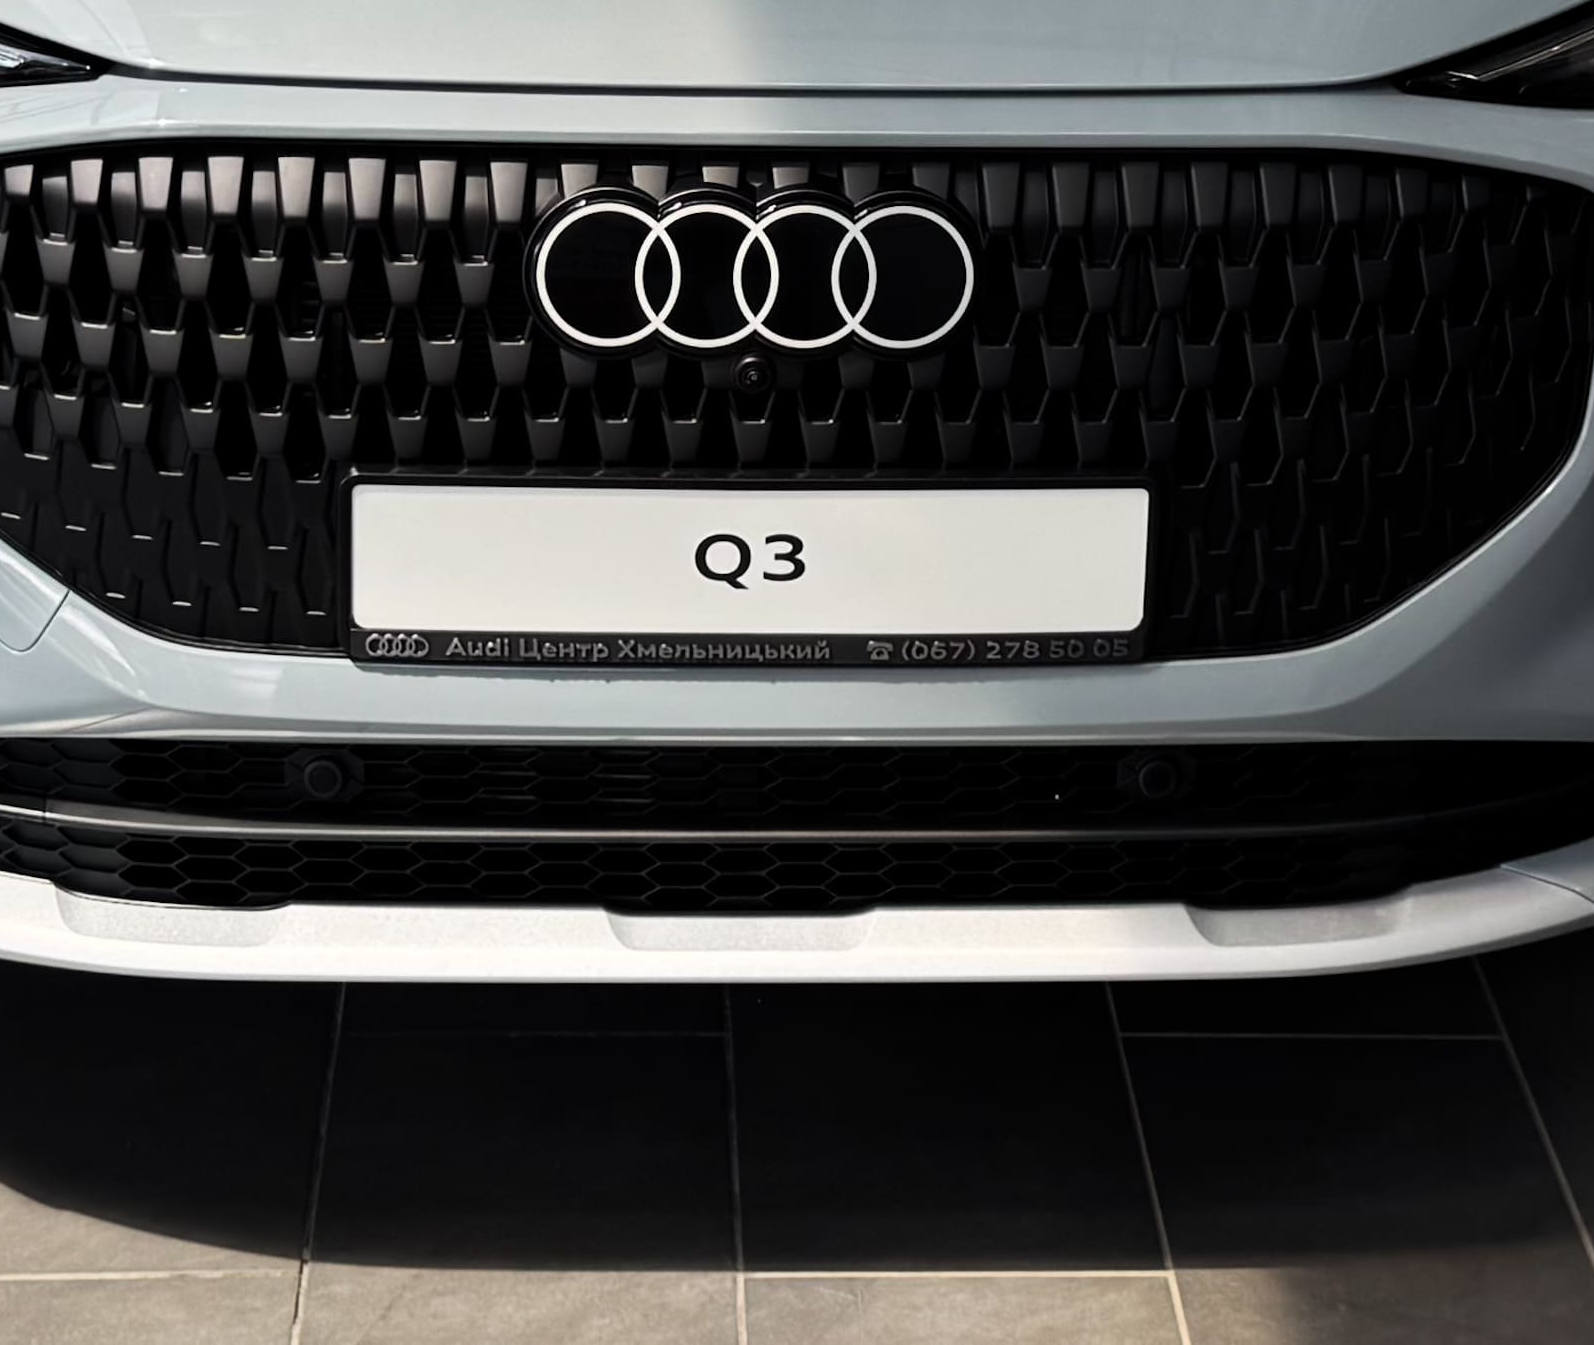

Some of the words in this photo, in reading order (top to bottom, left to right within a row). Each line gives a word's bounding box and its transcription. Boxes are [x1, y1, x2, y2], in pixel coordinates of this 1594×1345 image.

[694, 533, 806, 590] Q3
[445, 637, 509, 657] Audi
[519, 638, 610, 662] Центр
[618, 639, 831, 662] Хмельницький
[902, 640, 976, 660] (067)
[986, 640, 1041, 660] 278
[1049, 640, 1085, 659] 50
[1093, 639, 1130, 659] 05
